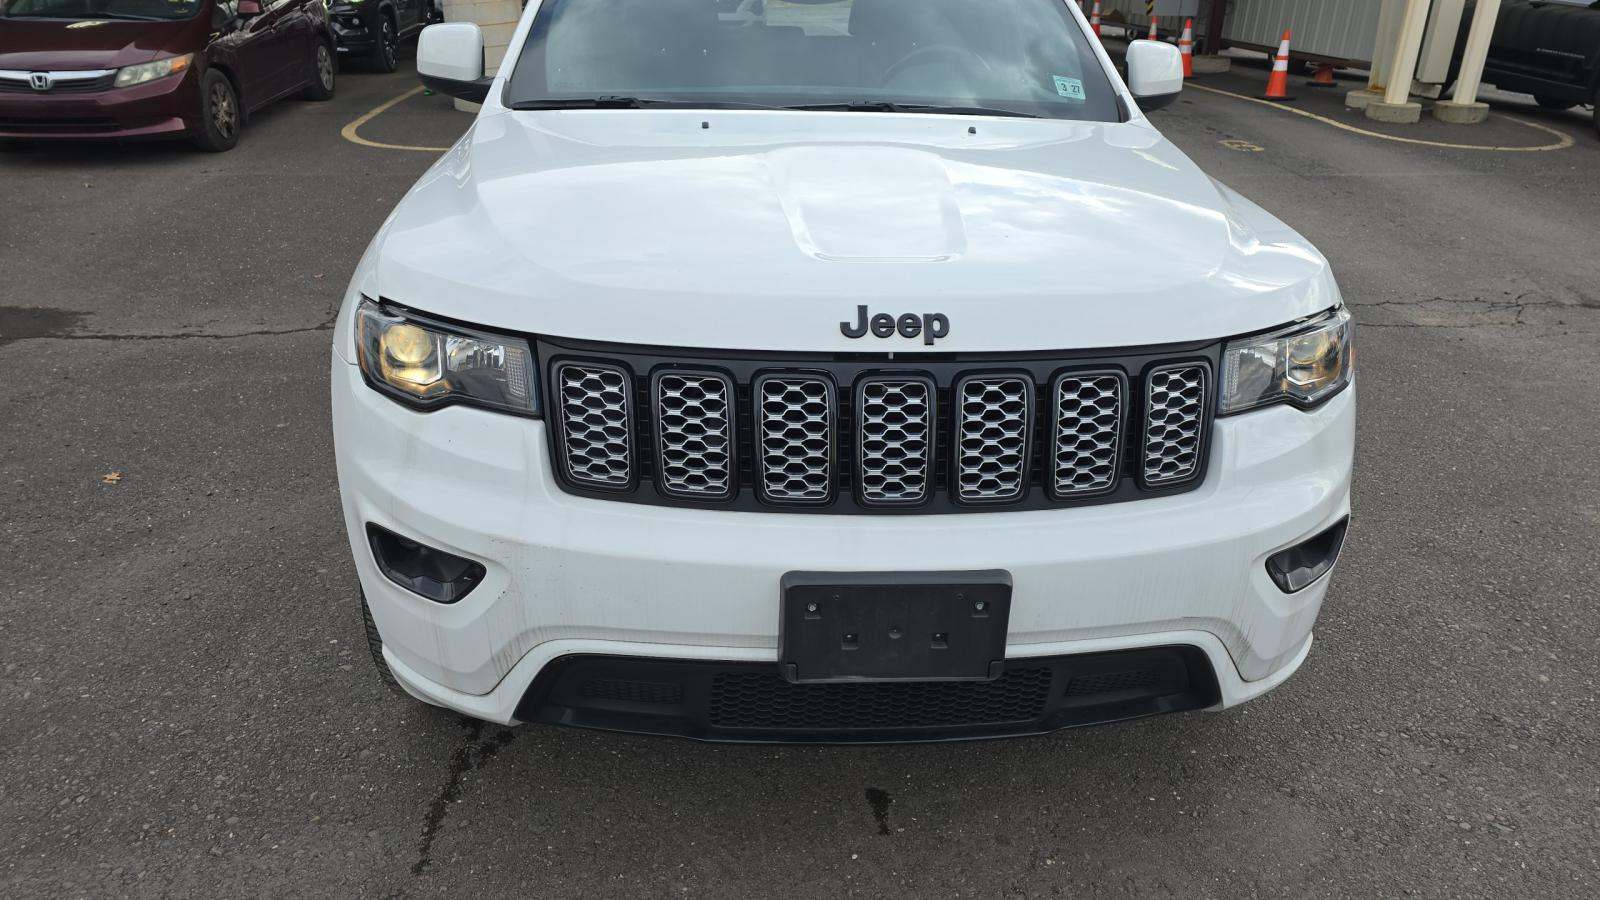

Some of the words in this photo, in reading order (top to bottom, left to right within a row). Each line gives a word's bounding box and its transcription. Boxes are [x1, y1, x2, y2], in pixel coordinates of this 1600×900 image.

[1061, 82, 1068, 92] 3
[1071, 84, 1081, 94] 27
[840, 304, 950, 346] Jeep
